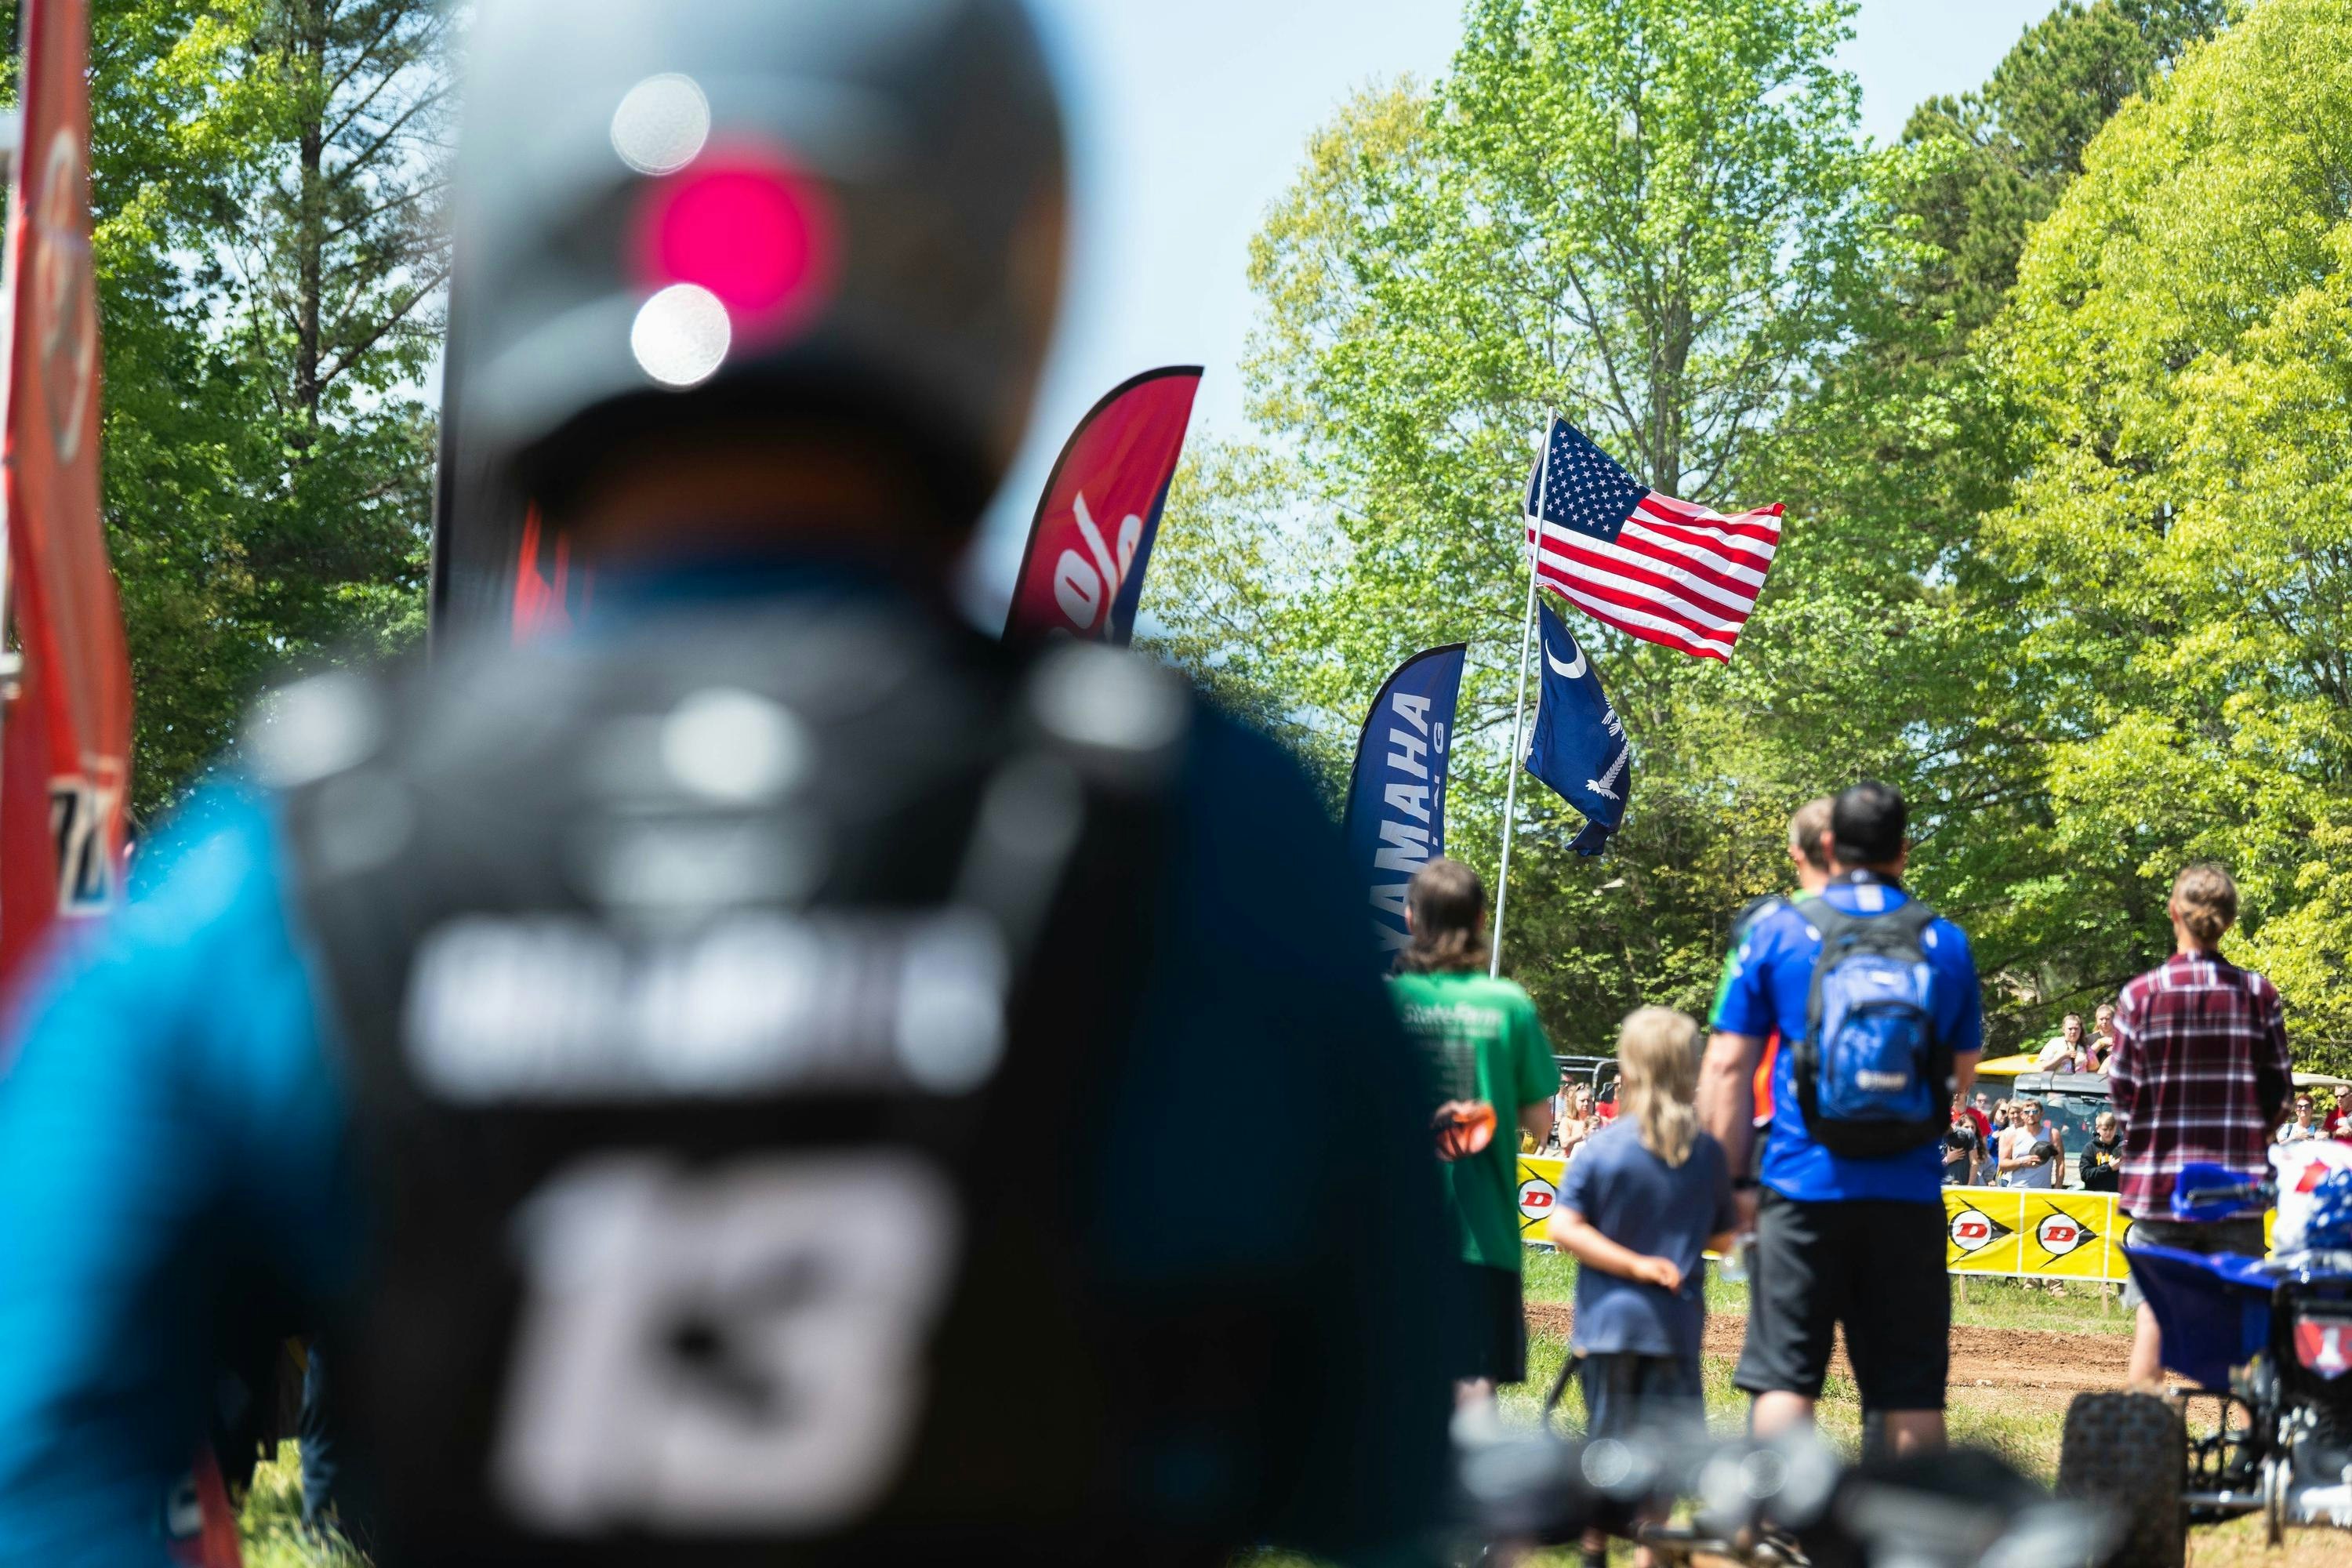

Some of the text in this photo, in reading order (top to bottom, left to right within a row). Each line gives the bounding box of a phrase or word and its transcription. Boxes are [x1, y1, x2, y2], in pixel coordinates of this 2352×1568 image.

[1052, 489, 1142, 640] 0%
[1521, 1191, 1553, 1207] D
[1956, 1222, 1988, 1239] D
[2043, 1225, 2077, 1243] D
